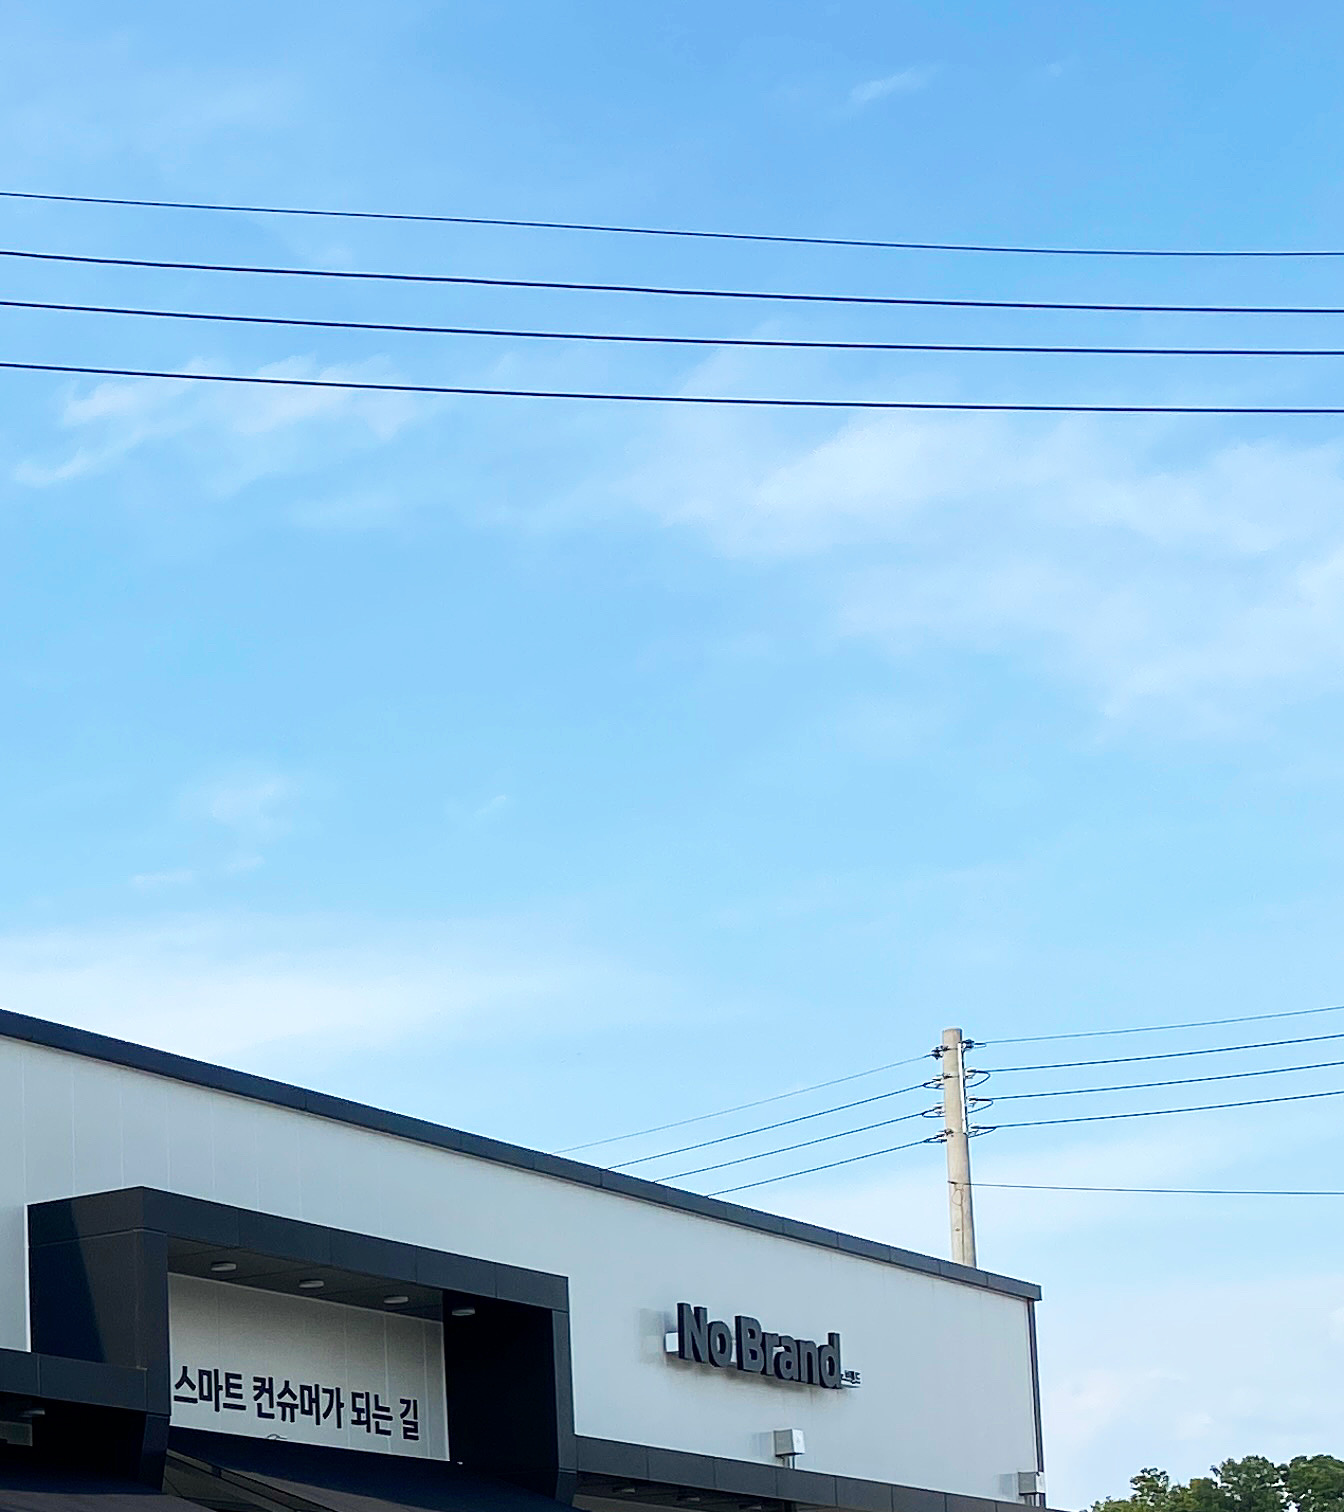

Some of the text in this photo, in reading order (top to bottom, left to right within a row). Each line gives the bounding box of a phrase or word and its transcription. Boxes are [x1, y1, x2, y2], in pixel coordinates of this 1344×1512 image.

[677, 1302, 842, 1389] No Brand
[173, 1366, 420, 1441] 스마트 컨슈머가 되는 길
